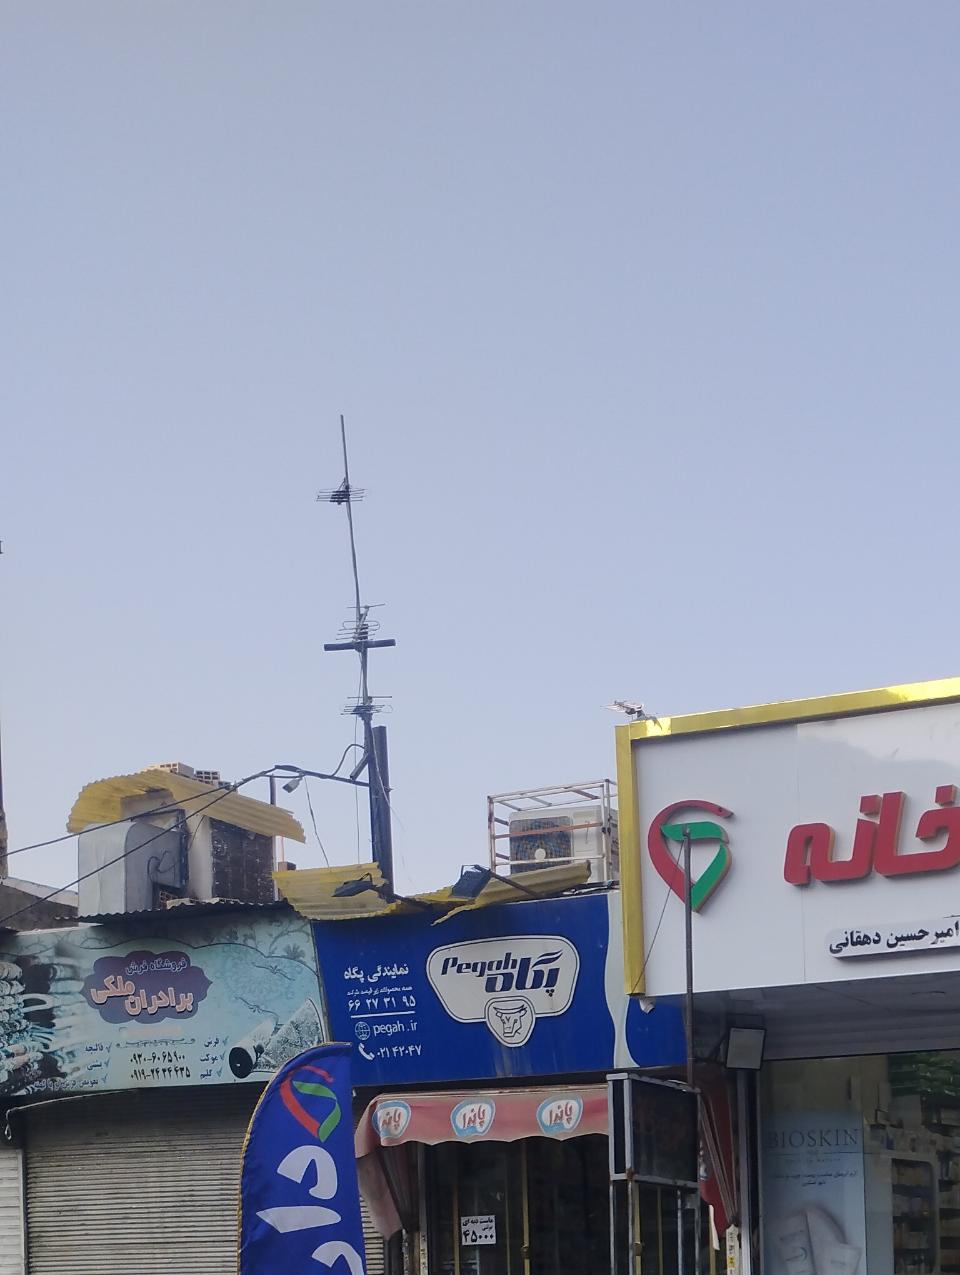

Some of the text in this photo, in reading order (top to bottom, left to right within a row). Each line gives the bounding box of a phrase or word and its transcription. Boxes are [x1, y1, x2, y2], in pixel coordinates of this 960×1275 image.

[829, 928, 881, 954] دهقانی
[125, 957, 188, 975] فروشگاه فرش
[344, 964, 409, 983] نمایندگی پگاه
[441, 952, 518, 977] Pegah
[485, 950, 564, 997] پگاه
[90, 975, 135, 1004] ملکی
[125, 987, 194, 1015] برادران
[462, 1102, 486, 1129] پاندا
[549, 1101, 574, 1126] پاندا
[463, 1229, 494, 1243] ۴۵۰۰۰
